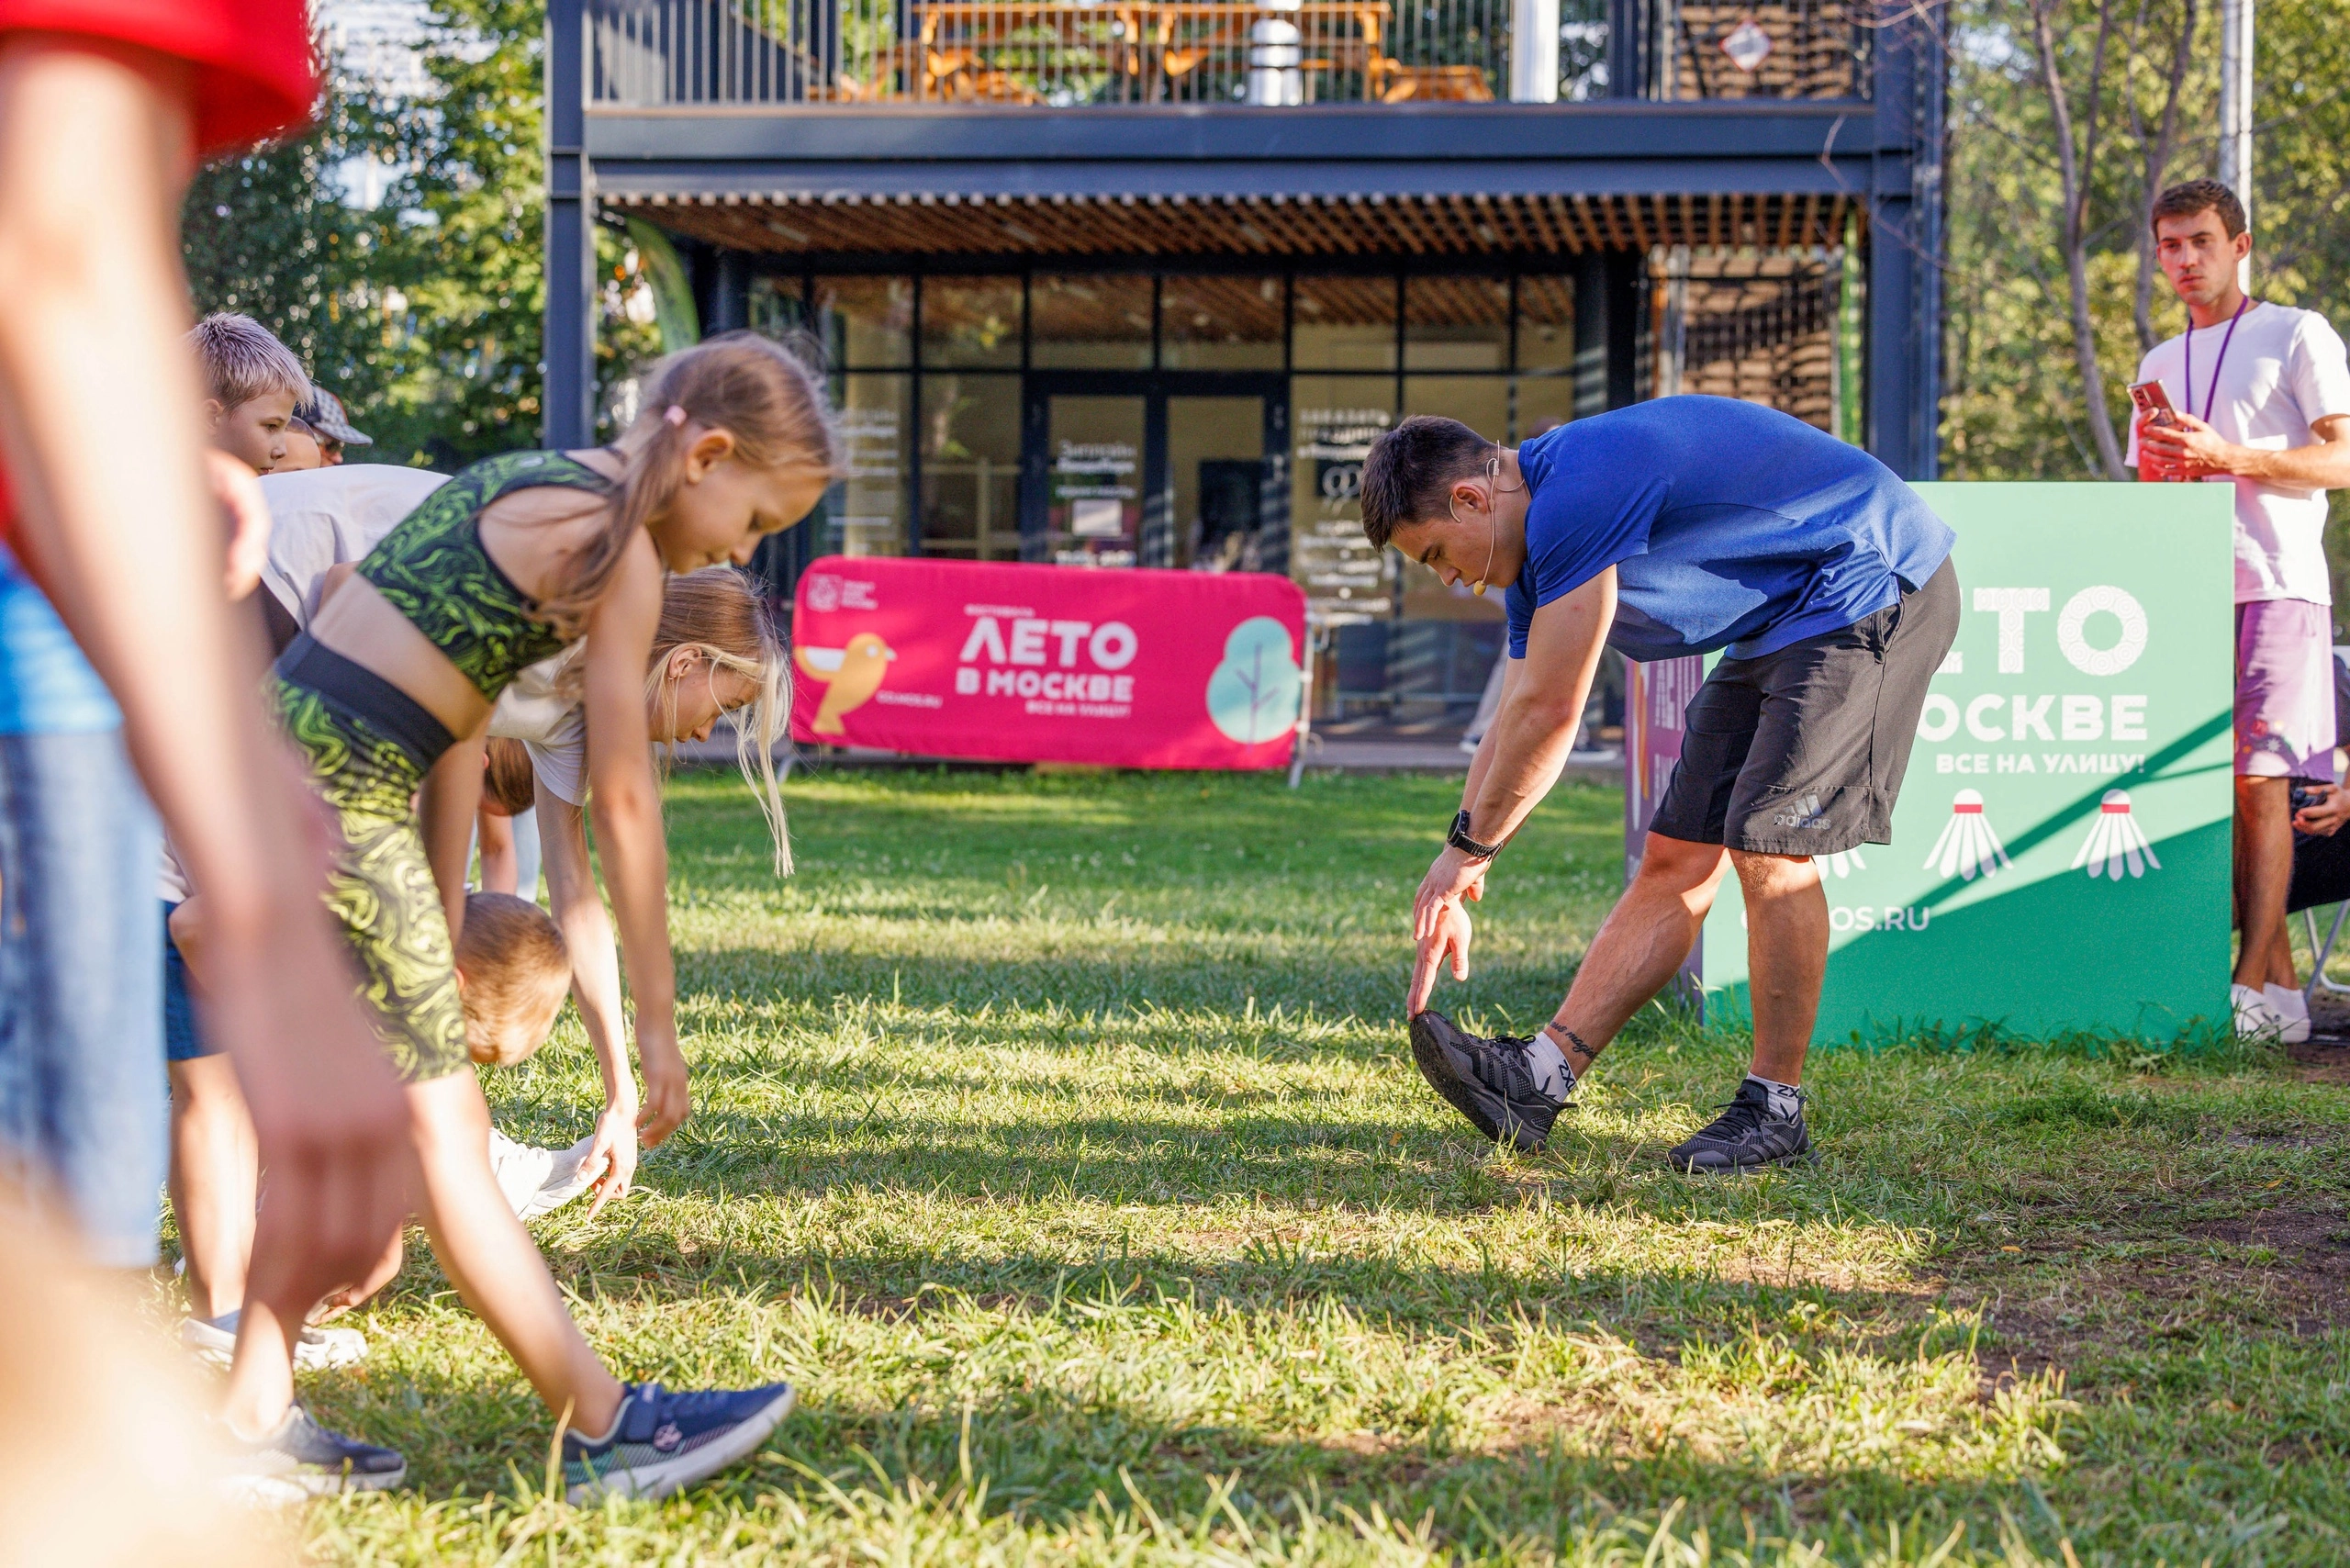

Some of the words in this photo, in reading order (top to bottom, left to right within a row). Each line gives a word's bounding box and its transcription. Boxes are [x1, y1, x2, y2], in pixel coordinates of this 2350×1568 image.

[959, 617, 1138, 670] ЛЕТО
[1934, 585, 2148, 676] ТО
[957, 667, 980, 695] В
[987, 669, 1135, 702] МОСКВЕ
[1917, 693, 2148, 742] ОСКВЕ
[1936, 754, 1990, 774] ВСЕ
[1997, 754, 2036, 774] НА
[2042, 754, 2146, 774] УЛИЦУ!
[1774, 813, 1831, 830] adidas
